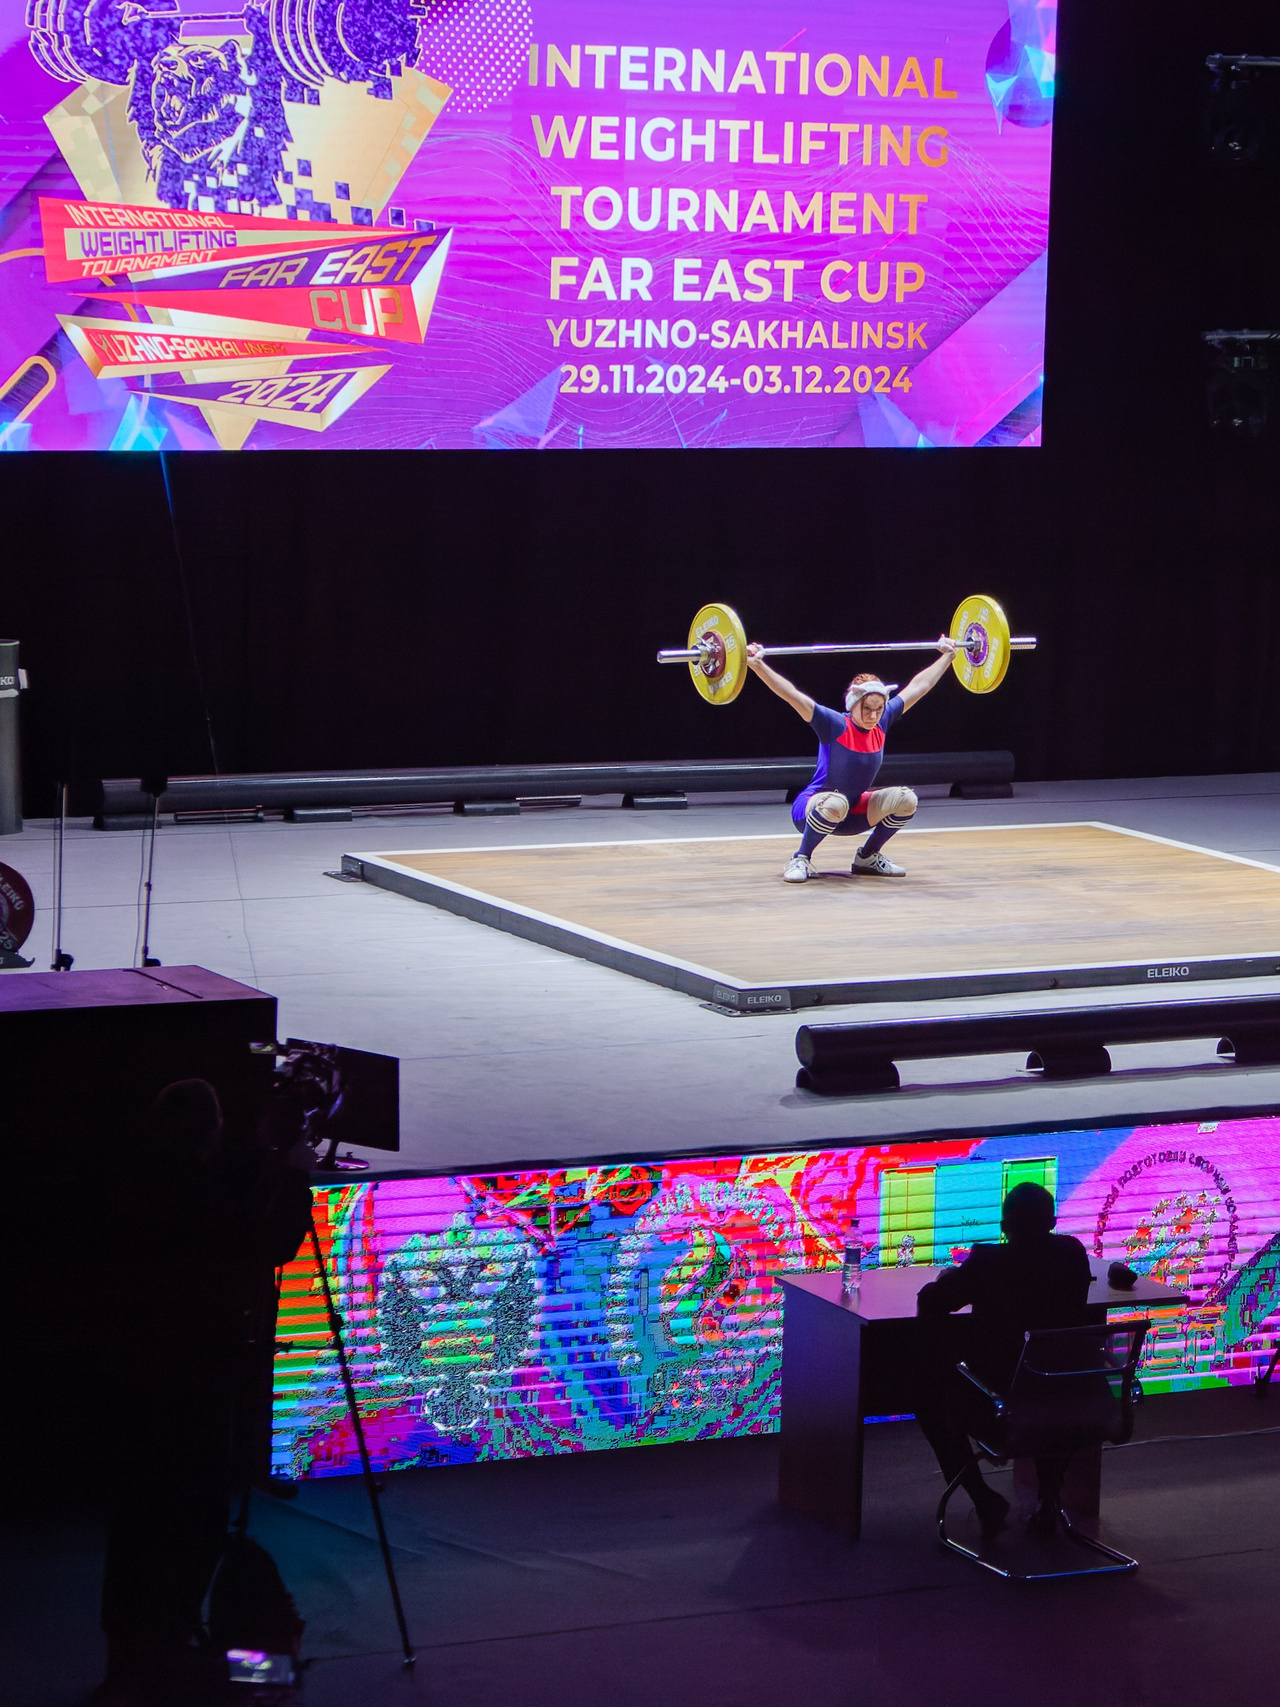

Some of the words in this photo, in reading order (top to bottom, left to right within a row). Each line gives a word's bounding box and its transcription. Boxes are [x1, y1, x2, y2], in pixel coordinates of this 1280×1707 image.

[528, 44, 957, 98] INTERNATIONAL
[531, 115, 949, 167] WEIGHTLIFTING
[65, 204, 233, 229] INTERNATIONAL
[551, 186, 928, 235] TOURNAMENT
[80, 230, 237, 258] WEIGHTLIFTING
[81, 250, 217, 277] TOURNAMENT
[219, 257, 307, 288] FAR
[310, 235, 437, 285] EAST
[549, 257, 654, 300] FAR
[673, 258, 804, 302] EAST
[820, 260, 926, 303] CUP
[310, 289, 403, 337] CUP
[90, 332, 287, 364] YUZHNO-SAKHALINSK
[547, 319, 928, 350] YUZHNO-SAKHALINSK
[217, 377, 337, 411] 2024
[559, 364, 913, 394] 29.11.2024-03.12.2024
[1147, 966, 1190, 979] ELEIKO
[747, 994, 782, 1005] ELEIKO
